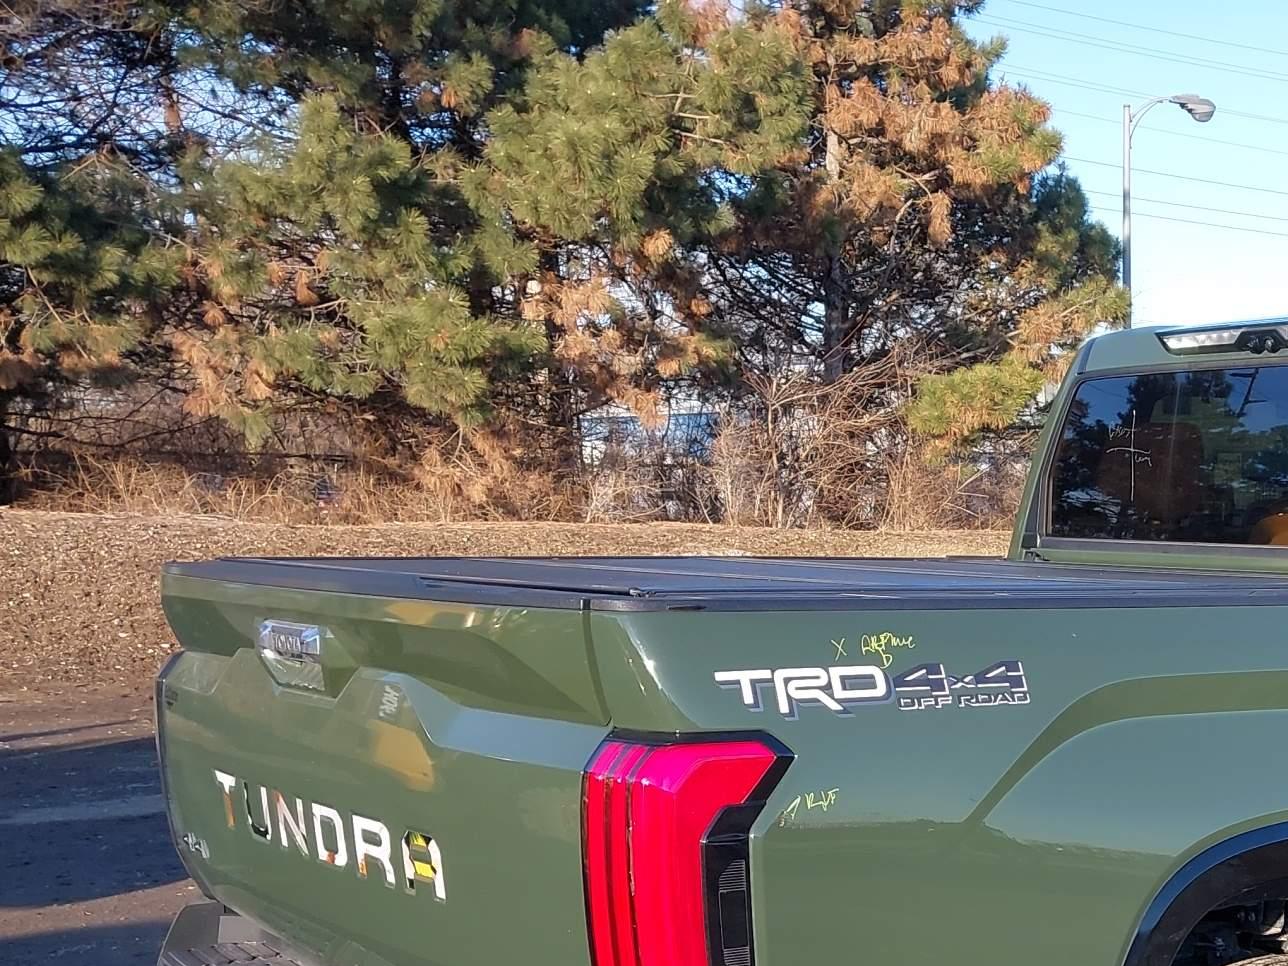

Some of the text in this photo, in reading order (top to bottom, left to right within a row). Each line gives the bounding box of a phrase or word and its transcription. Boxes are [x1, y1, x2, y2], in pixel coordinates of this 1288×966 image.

[714, 660, 1028, 721] TRD 4x4
[898, 691, 1031, 711] OFF ROAD
[213, 768, 447, 903] TUNDRA
